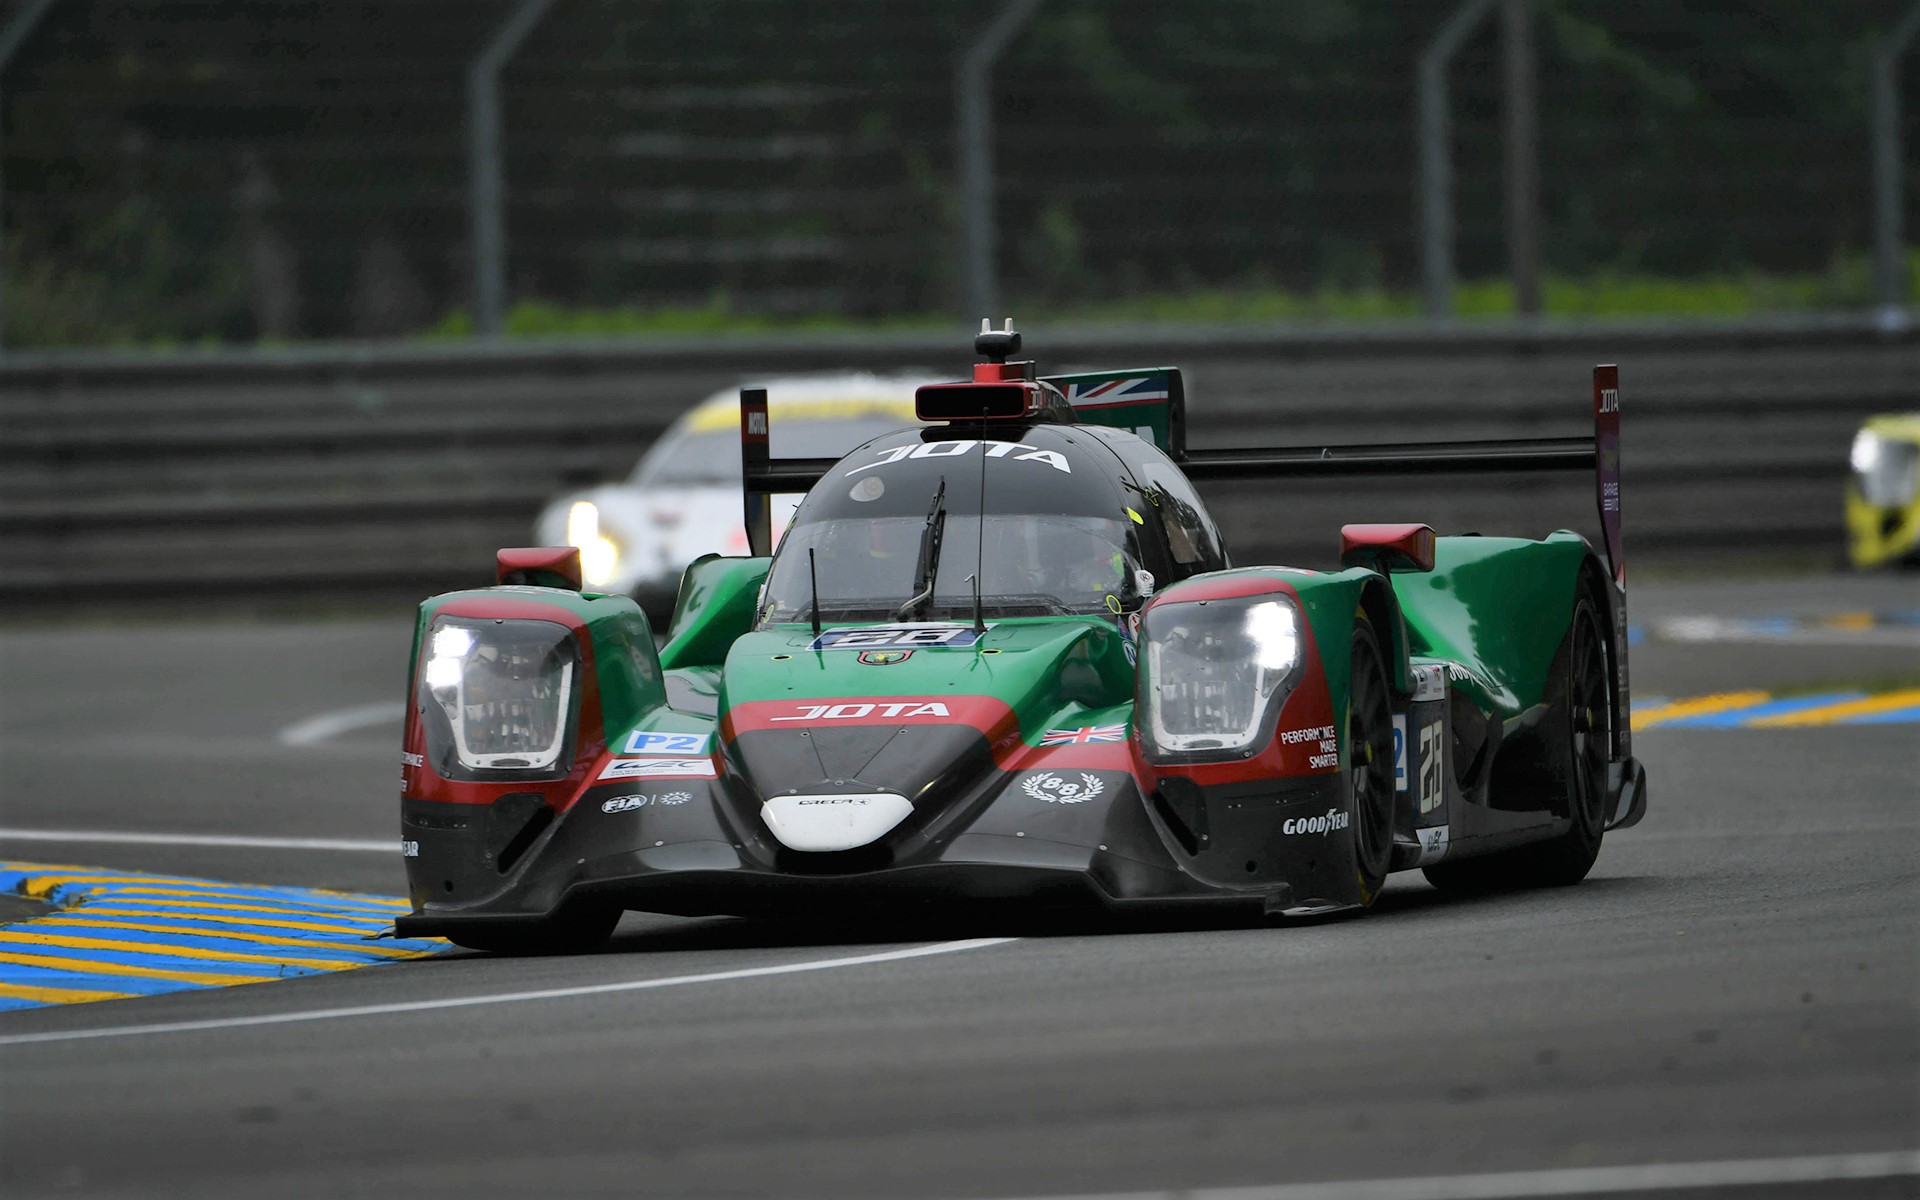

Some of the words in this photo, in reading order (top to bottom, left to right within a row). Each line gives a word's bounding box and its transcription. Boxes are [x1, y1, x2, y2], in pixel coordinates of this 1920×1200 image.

[1599, 388, 1619, 413] JOTA
[845, 440, 1072, 477] JOTA
[832, 628, 966, 647] 28
[770, 702, 950, 721] JOTA
[633, 734, 698, 750] P2
[1320, 740, 1337, 753] MADE
[613, 761, 704, 770] WEC
[1309, 753, 1339, 769] SMARTER
[1420, 720, 1443, 814] 28
[605, 796, 643, 812] FIA
